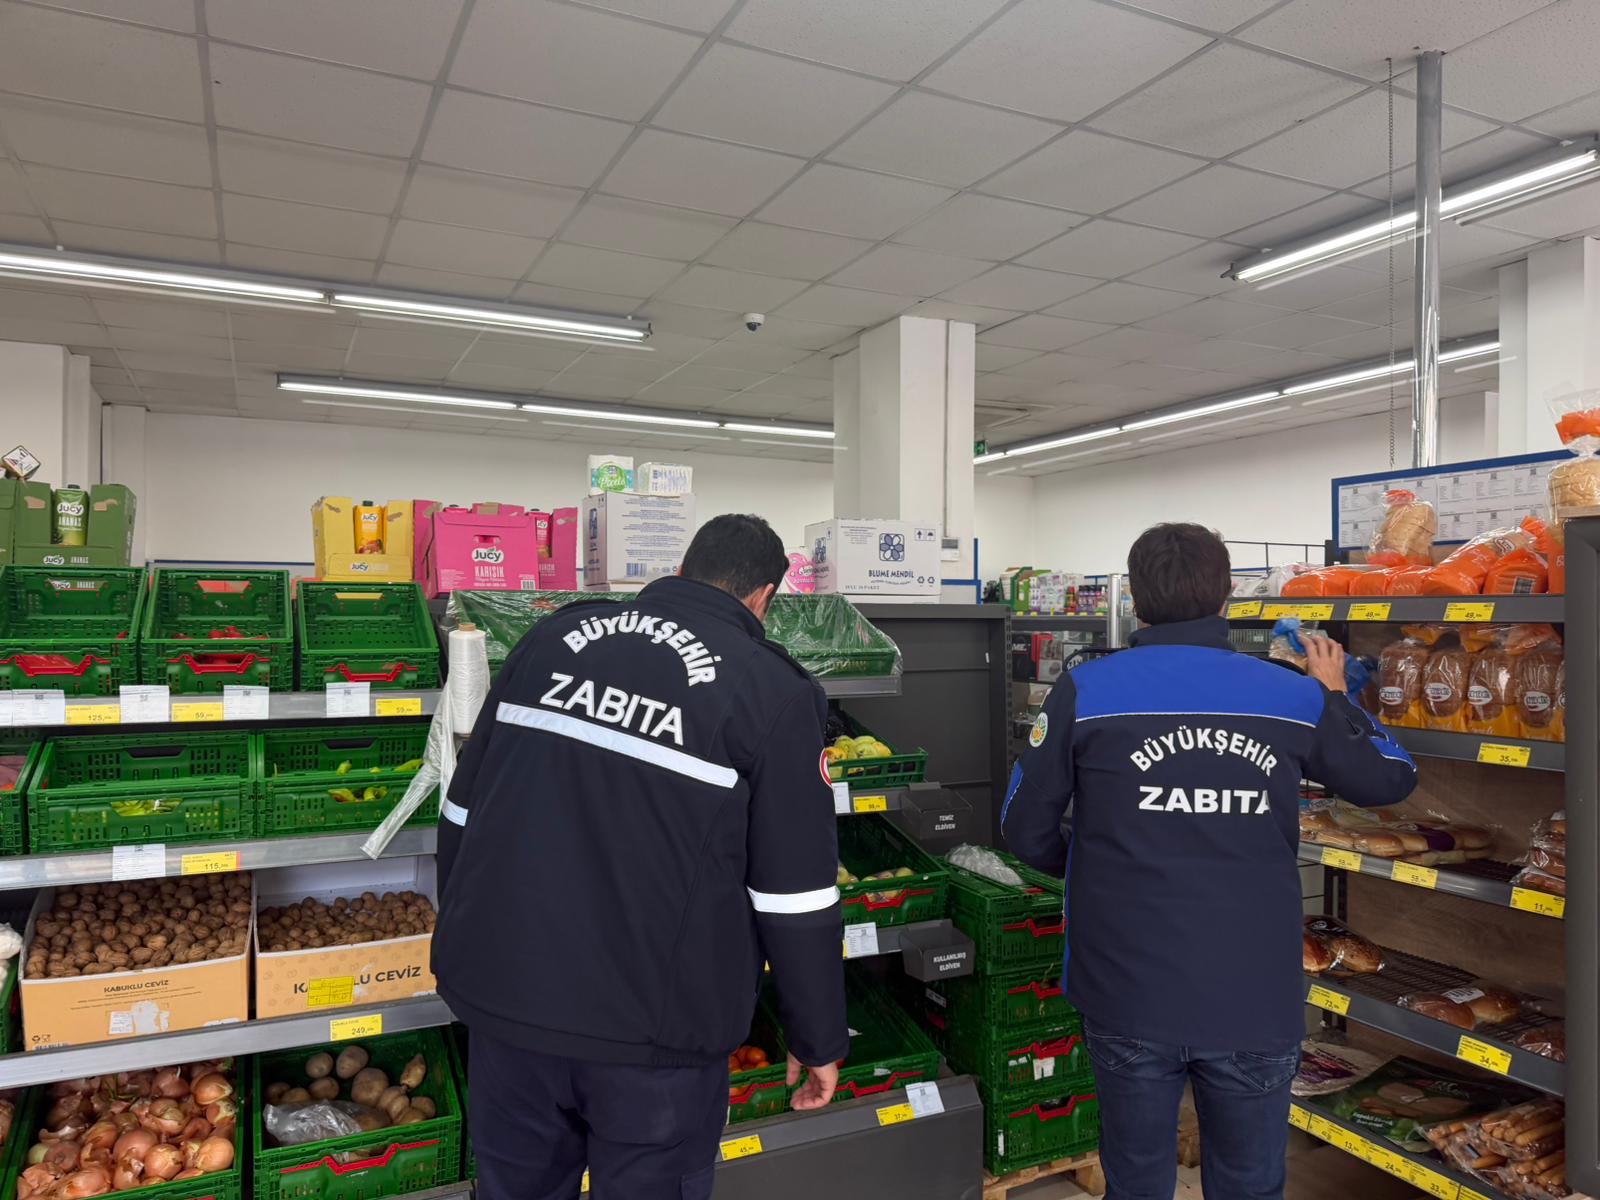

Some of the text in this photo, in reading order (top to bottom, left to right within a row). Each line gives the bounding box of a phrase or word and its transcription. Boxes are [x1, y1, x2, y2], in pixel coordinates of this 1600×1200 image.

[474, 549, 501, 562] Jucy
[868, 569, 890, 578] BLUME
[562, 610, 723, 687] BÜYÜKŞEHİR
[539, 672, 684, 746] ZABITA
[1130, 725, 1278, 777] BÜYÜKŞEHİR
[1138, 785, 1272, 815] ZABITA
[104, 979, 169, 993] KABUKLU CEVİZ
[375, 965, 422, 983] CEVİZ
